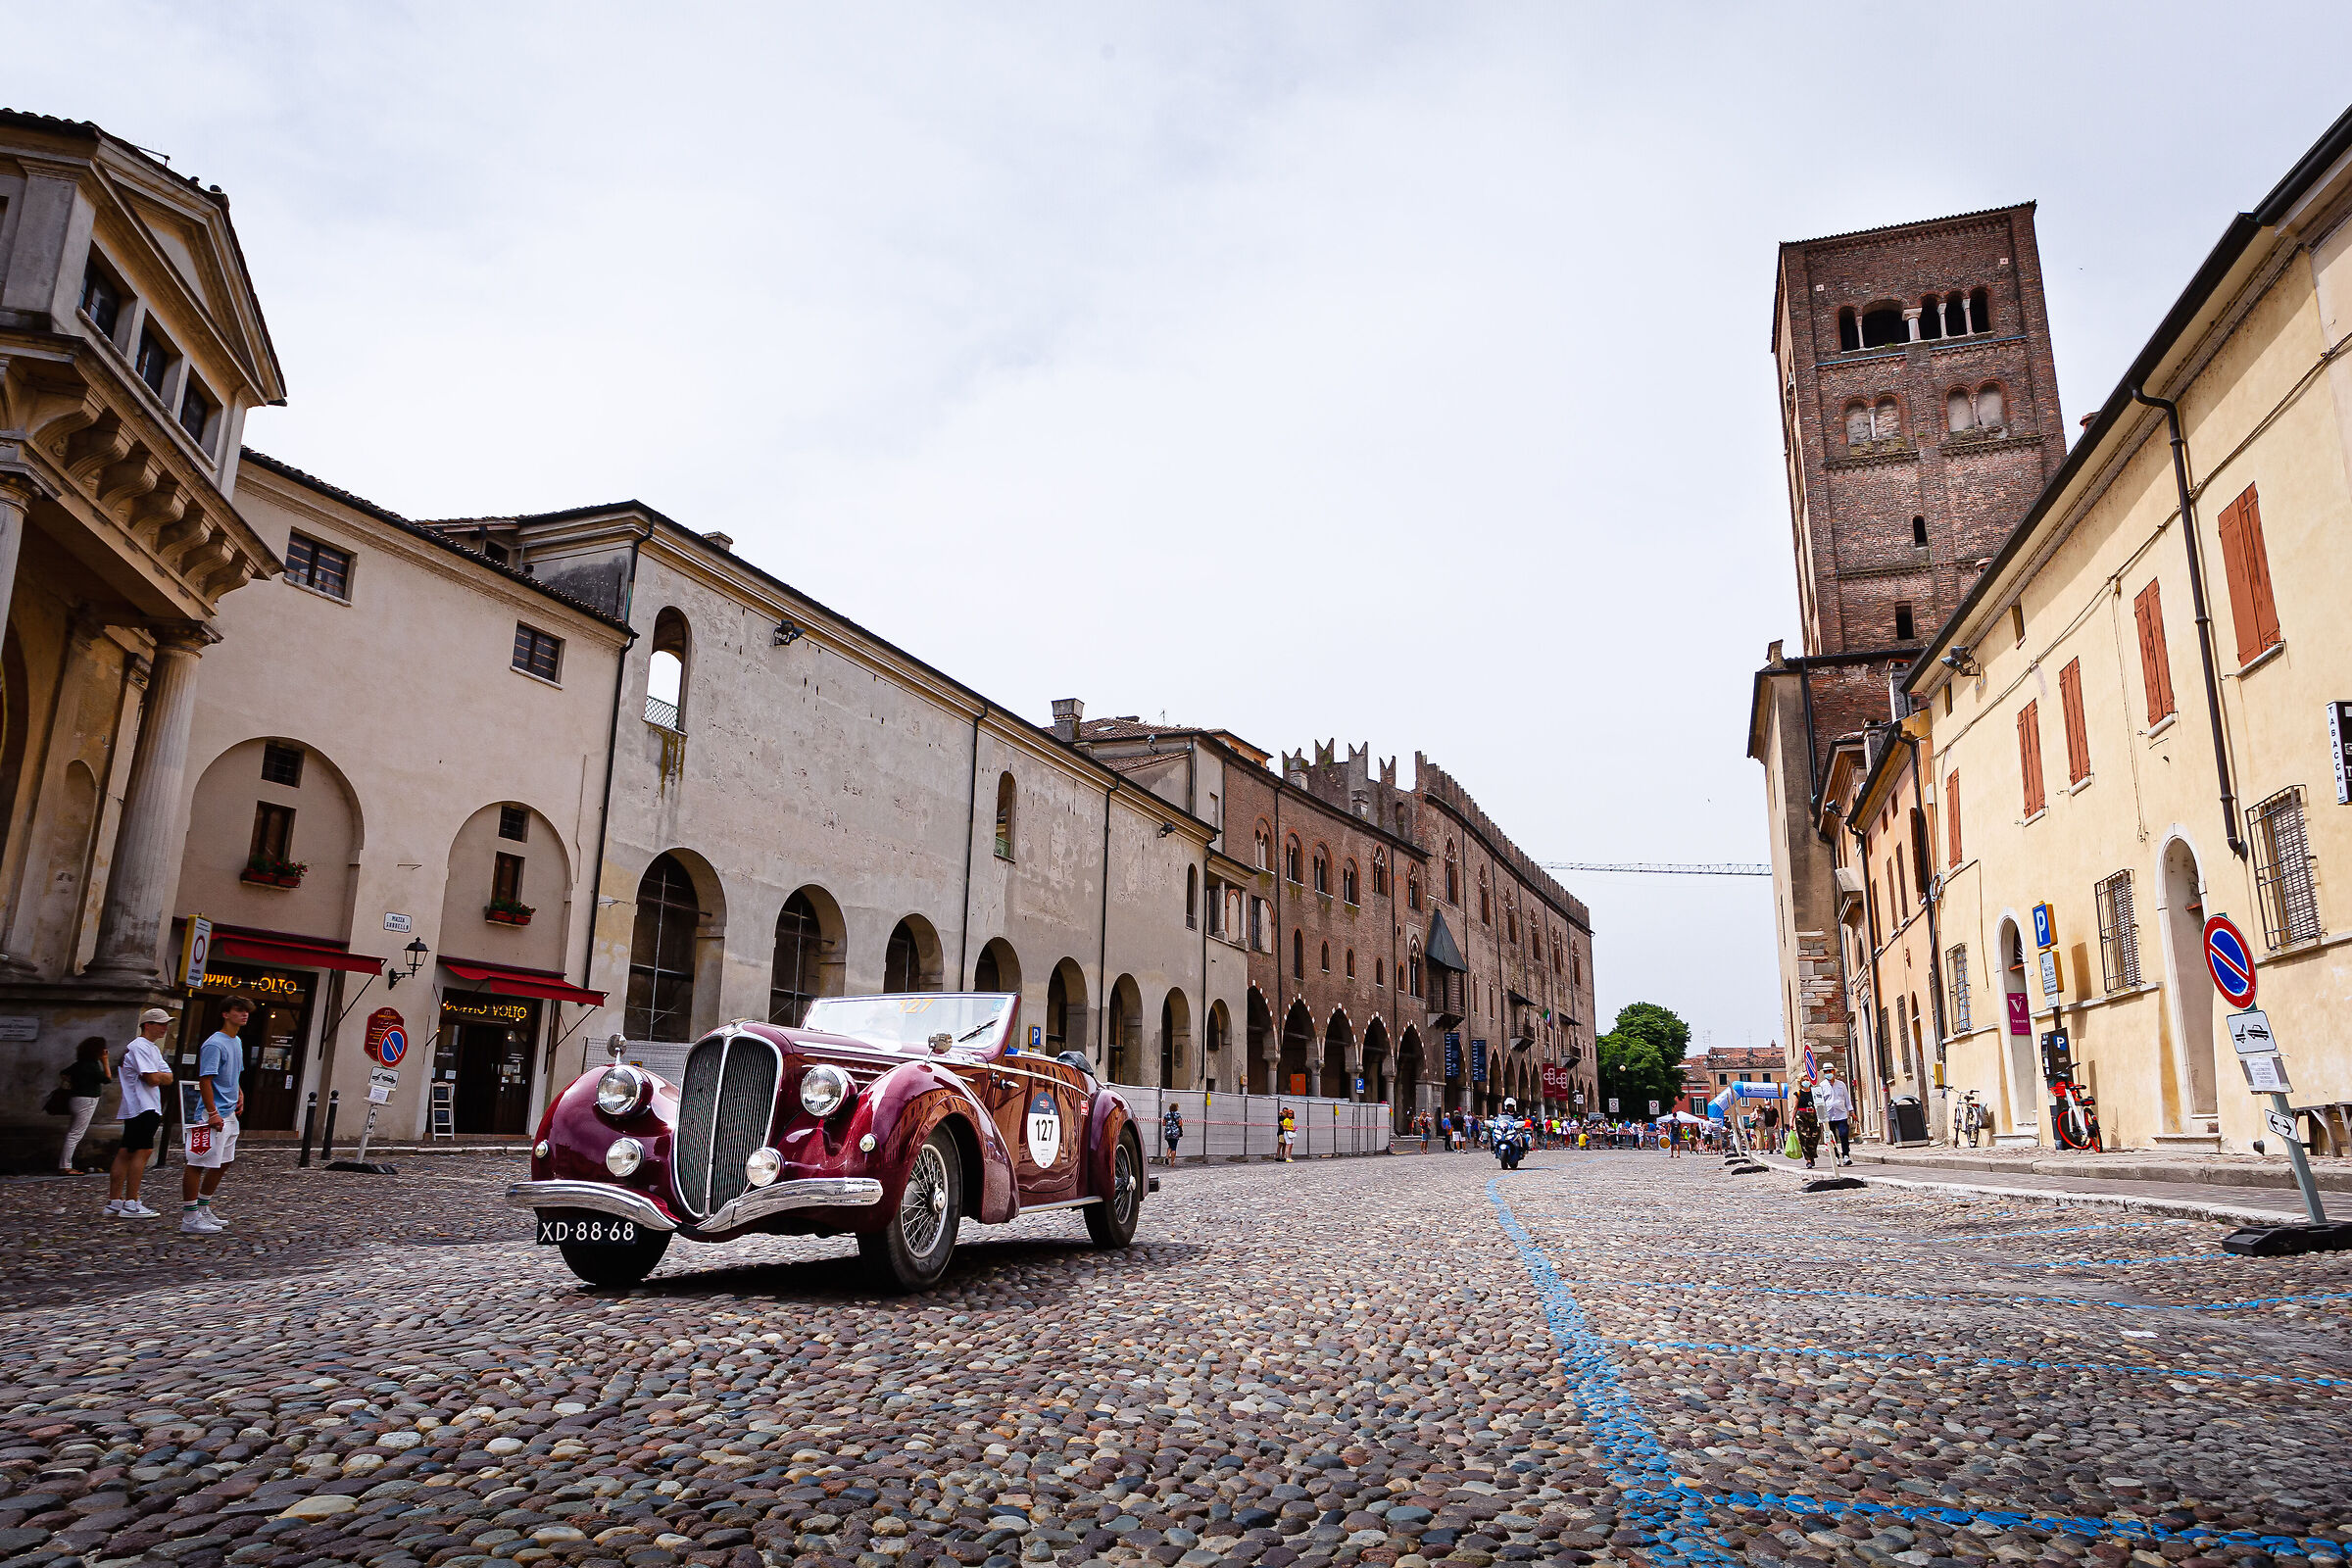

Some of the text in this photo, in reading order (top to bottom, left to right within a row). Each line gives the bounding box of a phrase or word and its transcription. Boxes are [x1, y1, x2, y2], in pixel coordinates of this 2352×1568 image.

[2328, 706, 2342, 794] TABACCHI
[204, 973, 242, 989] OPPIO
[493, 1004, 527, 1019] VOLTO
[898, 998, 936, 1014] 127
[1035, 1119, 1054, 1142] 127
[539, 1221, 635, 1242] XD-88-68
